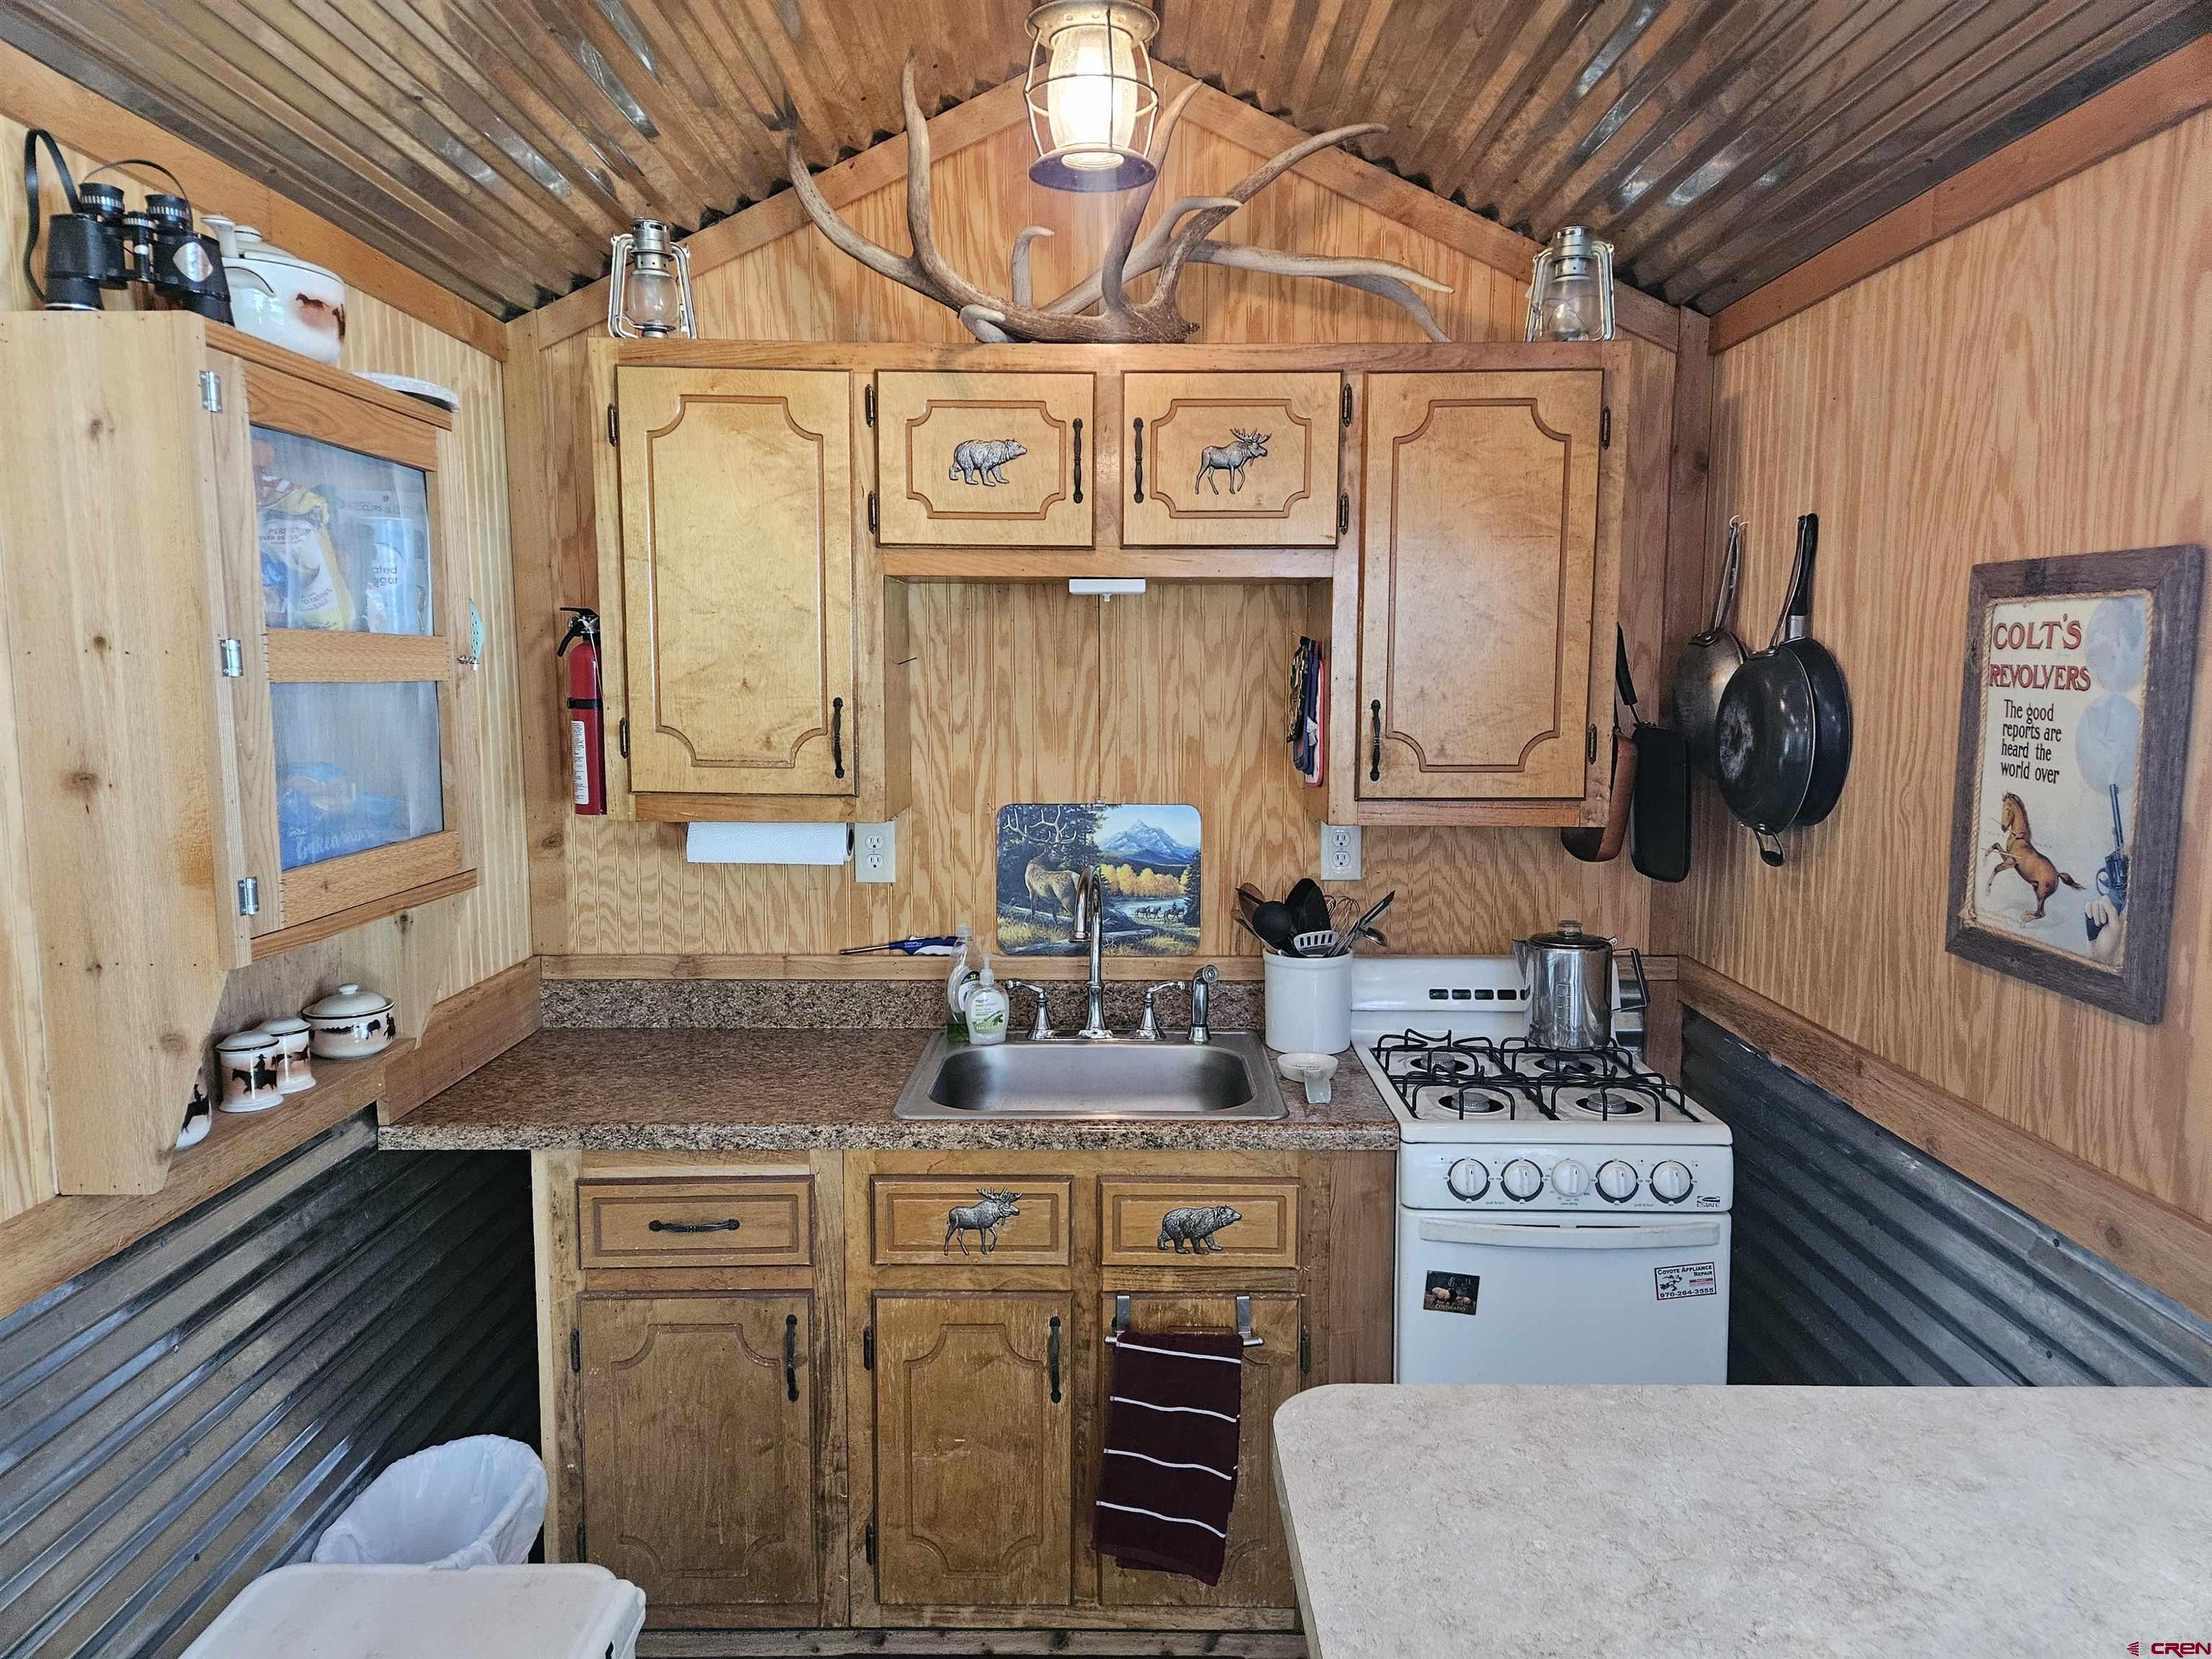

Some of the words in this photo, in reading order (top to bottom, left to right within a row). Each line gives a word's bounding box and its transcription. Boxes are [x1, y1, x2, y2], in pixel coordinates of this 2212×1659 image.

[372, 565, 397, 575] ated
[1992, 613, 2082, 650] COLT'S
[1989, 664, 2091, 691] REVOLVERS
[2004, 698, 2023, 719] The
[2026, 703, 2054, 724] good
[2002, 723, 2041, 742] reports
[2044, 727, 2062, 742] are
[2001, 738, 2029, 759] heard
[2036, 743, 2051, 761] the
[2000, 760, 2030, 780] world
[2035, 767, 2060, 784] over
[1659, 1287, 1714, 1298] 970-264-3555
